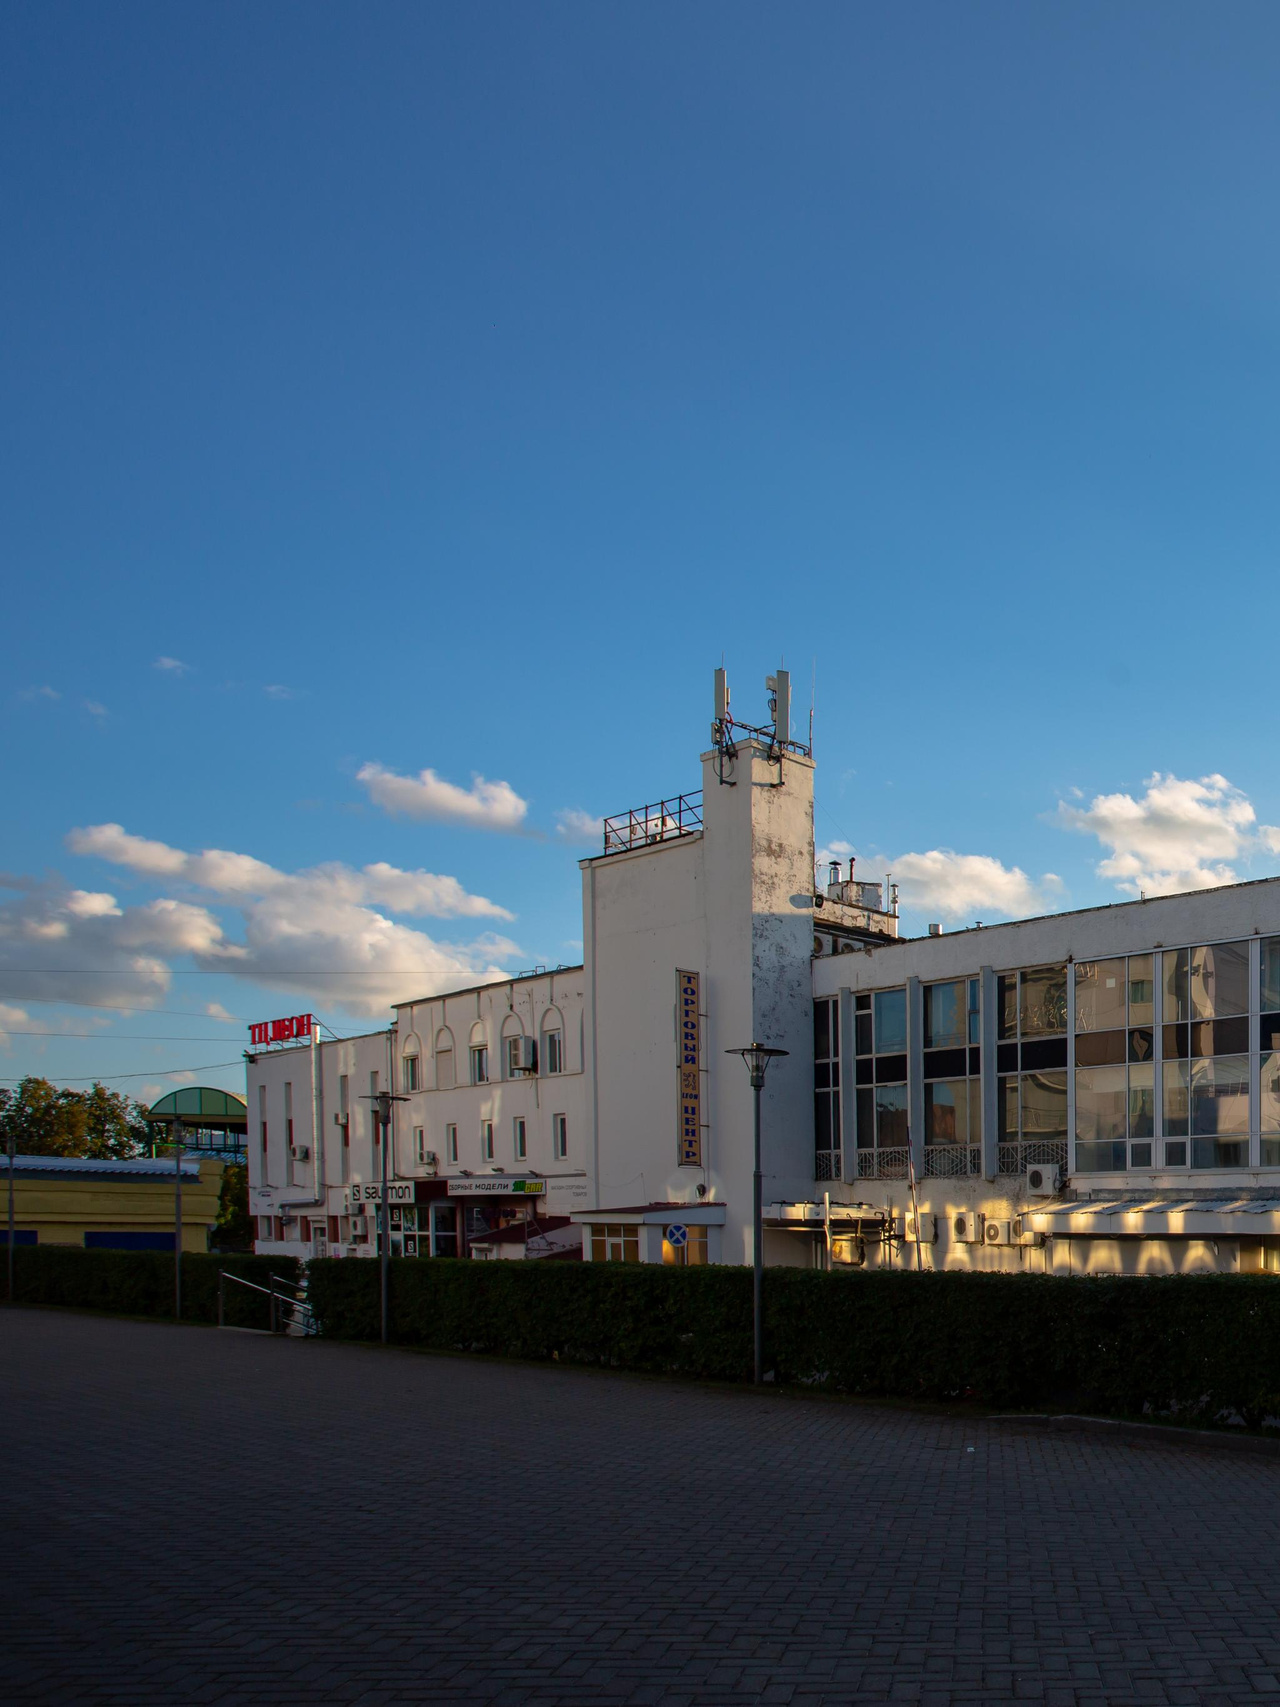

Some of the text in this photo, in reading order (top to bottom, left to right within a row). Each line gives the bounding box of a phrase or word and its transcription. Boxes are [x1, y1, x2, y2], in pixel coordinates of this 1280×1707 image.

[248, 1013, 313, 1046] ТЦ ЛЕОН
[682, 975, 697, 1065] ТОРГОВЫЙ
[682, 1092, 698, 1100] LEON
[684, 1105, 698, 1159] ЦЕНТР
[364, 1185, 411, 1199] salmon
[474, 1183, 509, 1191] МОДЕЛИ
